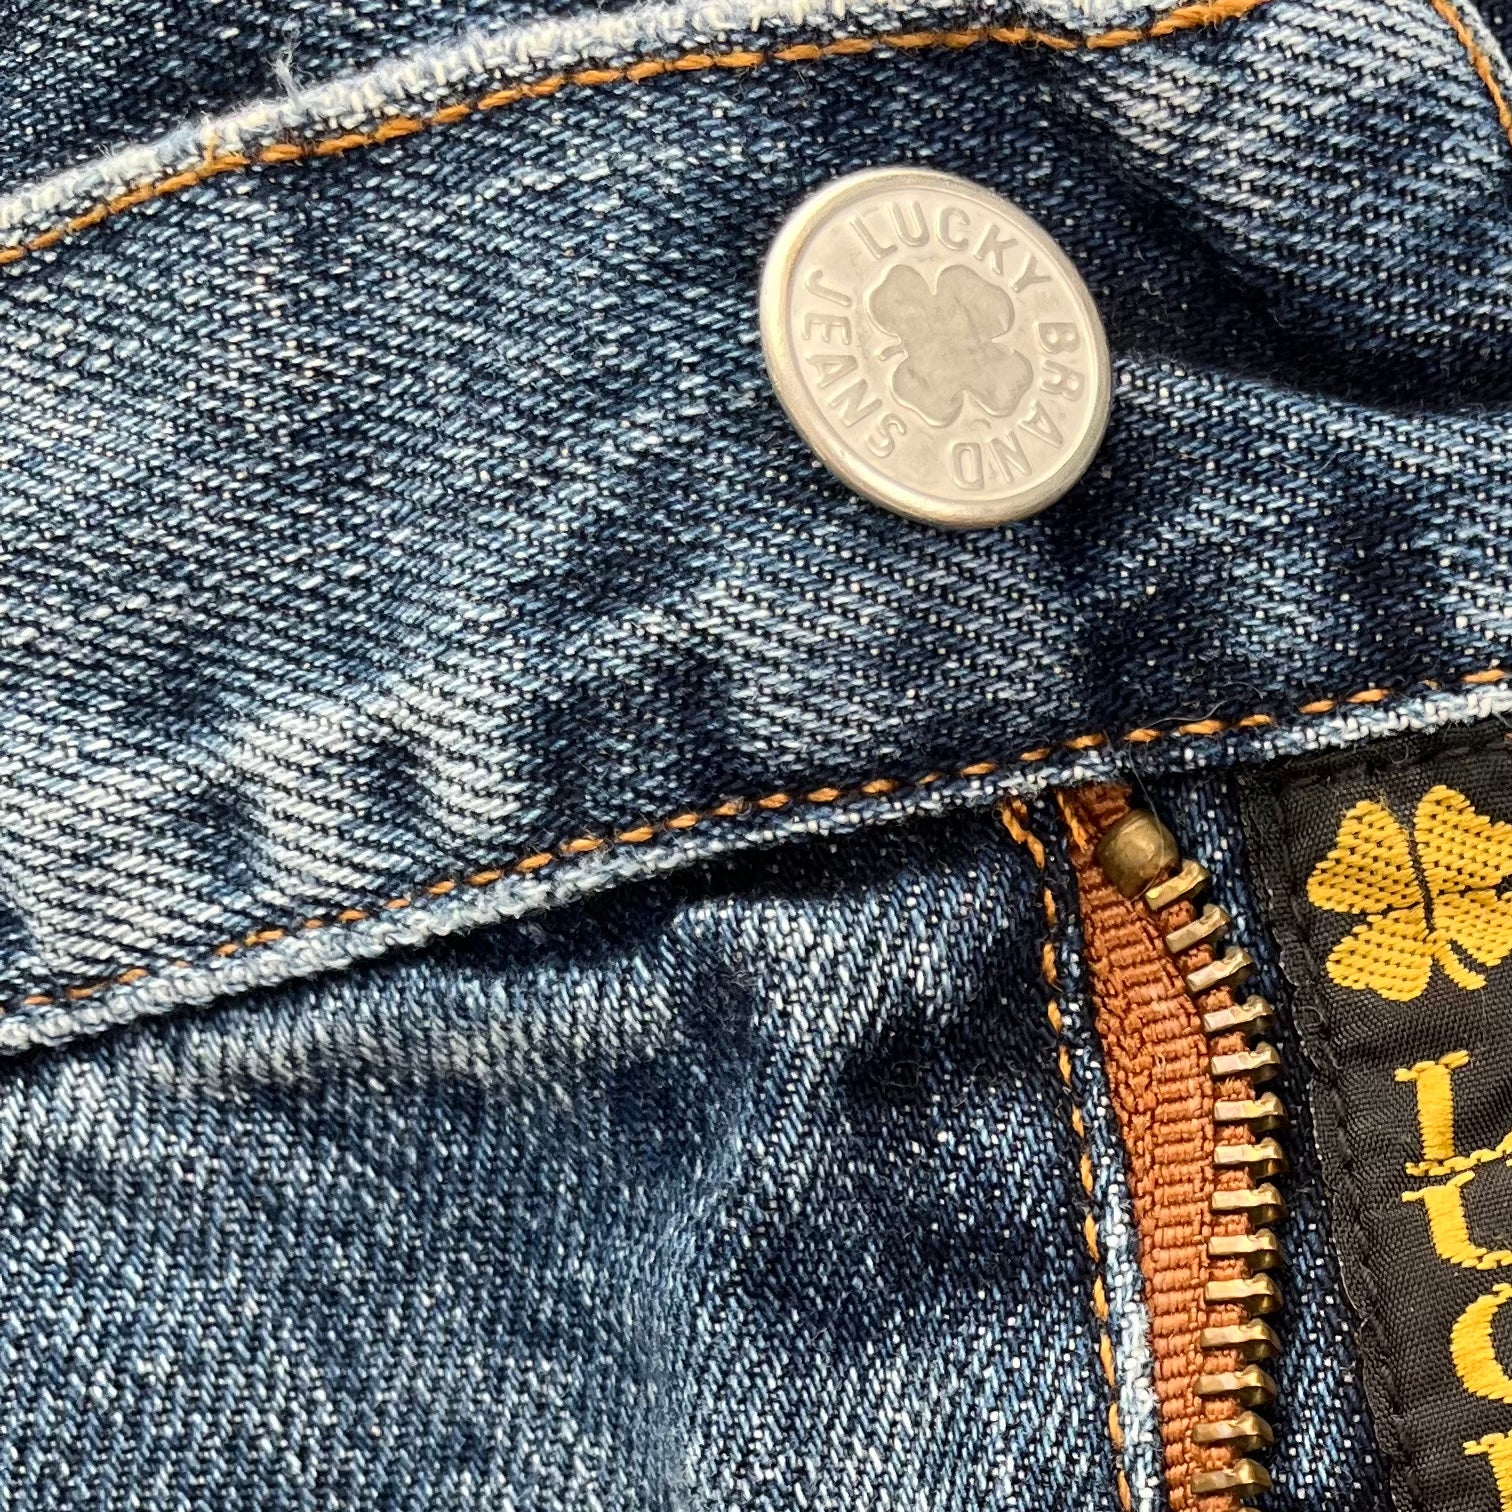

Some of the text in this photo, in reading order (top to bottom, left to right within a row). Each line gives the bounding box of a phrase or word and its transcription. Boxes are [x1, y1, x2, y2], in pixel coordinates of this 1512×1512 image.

[803, 200, 1085, 490] LUCKY BRAND JEANS
